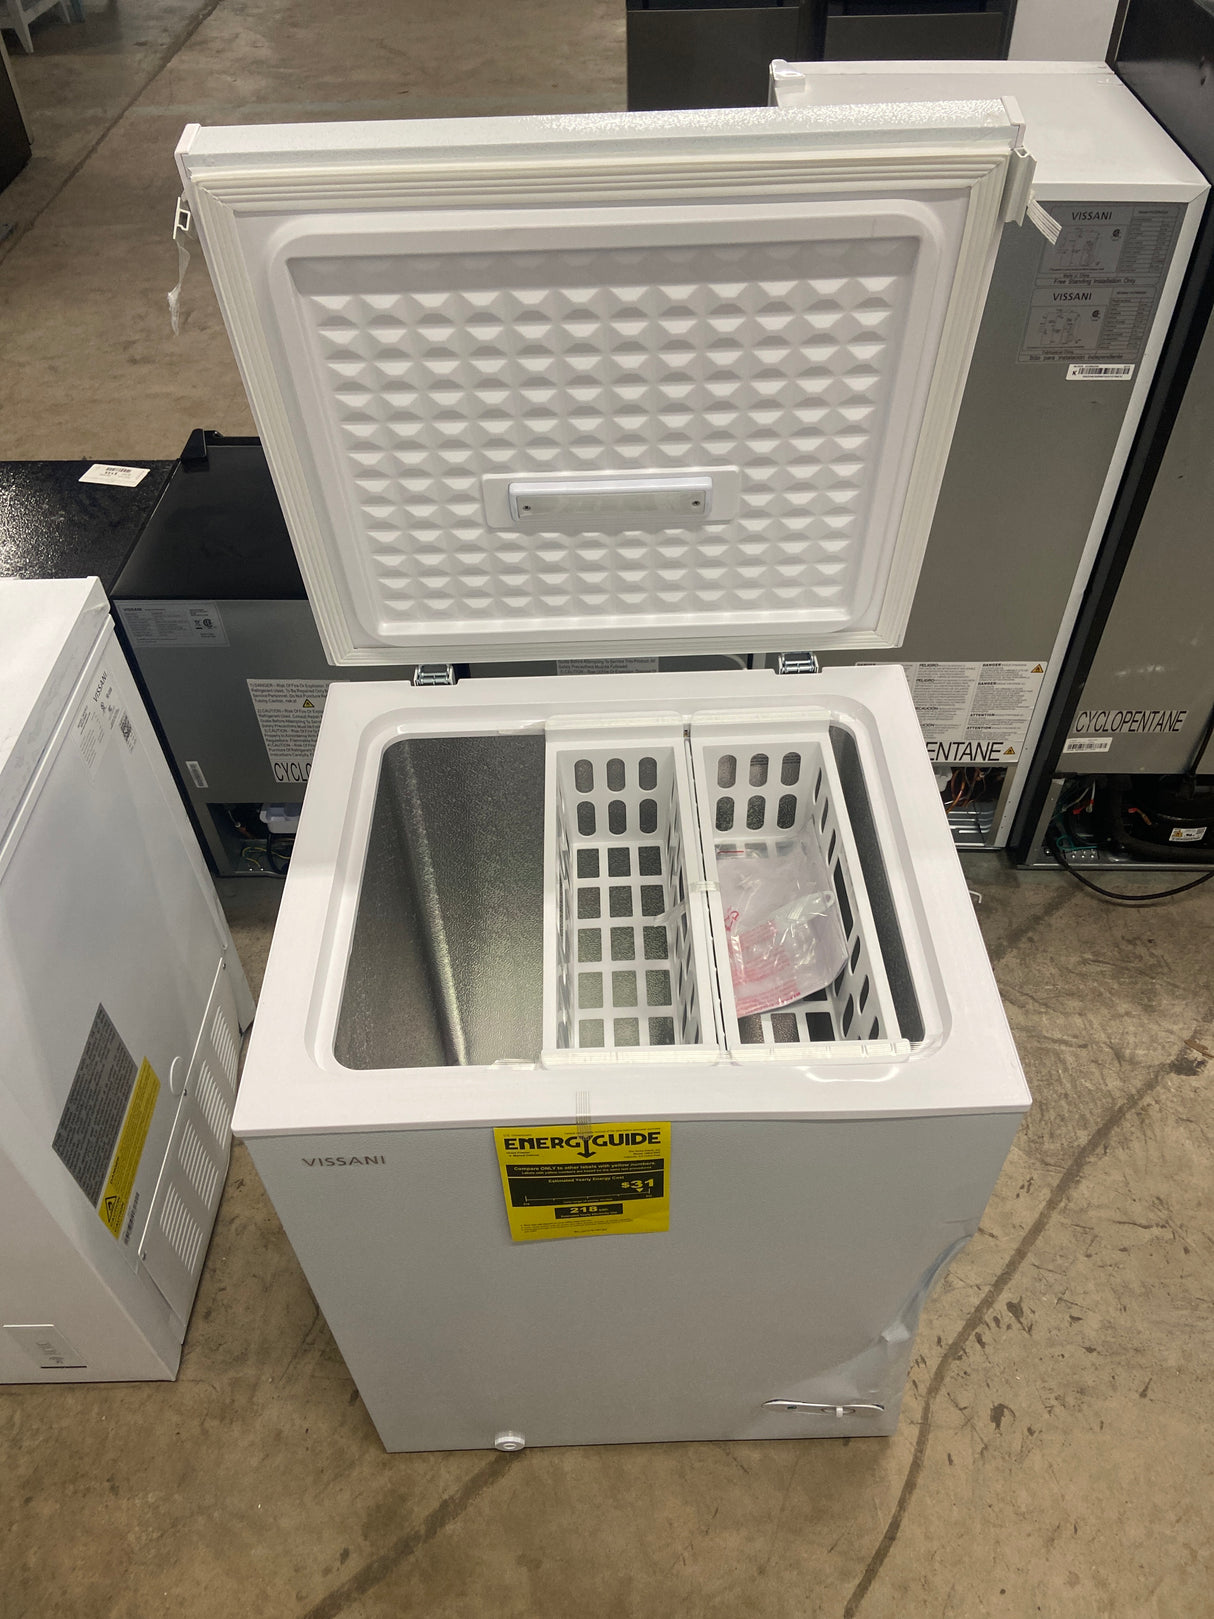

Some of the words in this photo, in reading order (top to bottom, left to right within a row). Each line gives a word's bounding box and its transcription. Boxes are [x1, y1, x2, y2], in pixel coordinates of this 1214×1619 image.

[1072, 211, 1112, 220] VISSANI
[1053, 292, 1092, 301] VISSANI
[1076, 710, 1187, 732] CYCLOPENTANE
[302, 1155, 386, 1167] VISSANI
[621, 1178, 655, 1189] $31
[569, 1205, 598, 1214] 218
